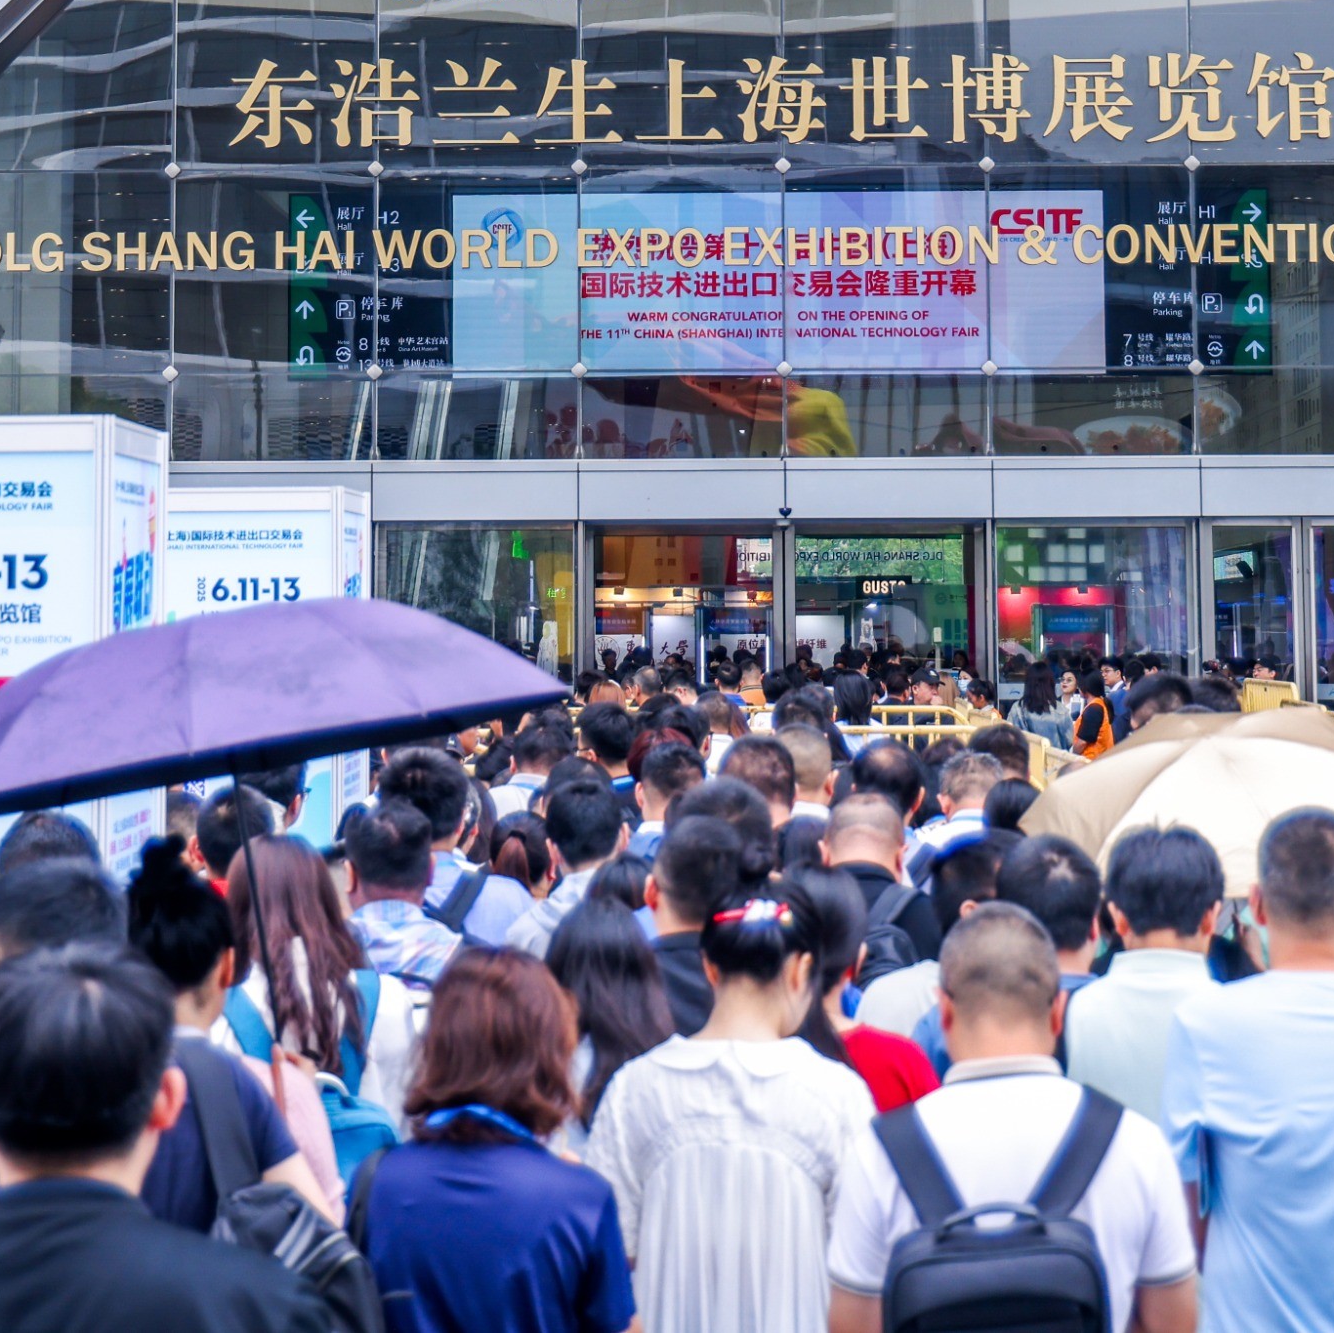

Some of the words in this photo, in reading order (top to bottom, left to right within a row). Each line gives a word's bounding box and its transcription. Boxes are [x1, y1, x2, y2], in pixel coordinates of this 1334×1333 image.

[337, 207, 365, 220] 展厅
[1157, 202, 1186, 214] 展厅
[1198, 205, 1216, 218] H1
[337, 223, 352, 231] Hall
[991, 208, 1083, 235] CSITF
[1158, 217, 1173, 225] Hall
[81, 230, 255, 272] SHANG
[276, 231, 354, 269] HAI
[373, 228, 558, 269] WORLD
[578, 227, 706, 268] EXPO
[723, 225, 999, 266] EXHIBITION
[1019, 224, 1057, 265] &
[628, 311, 668, 323] WARM
[672, 311, 784, 322] CONGRATULATION
[798, 311, 818, 322] ON
[821, 310, 846, 321] THE
[850, 310, 908, 322] OPENING
[912, 309, 929, 321] OF
[1153, 308, 1183, 317] Parking
[581, 329, 602, 339] THE
[634, 328, 675, 339] CHINA
[678, 327, 753, 340] (SHANGHAI)
[756, 327, 856, 339] INTENATIONAL
[860, 326, 948, 338] TECHNOLOGY
[951, 326, 979, 337] FAIR
[1123, 333, 1133, 347] 7
[1165, 333, 1194, 342] 耀华路
[358, 337, 368, 351] 8
[1123, 354, 1134, 366] 8
[31, 502, 53, 511] FAIR
[197, 577, 206, 602] 2025
[211, 576, 301, 602] 6.11-13
[14, 634, 72, 644] EXHIBITION
